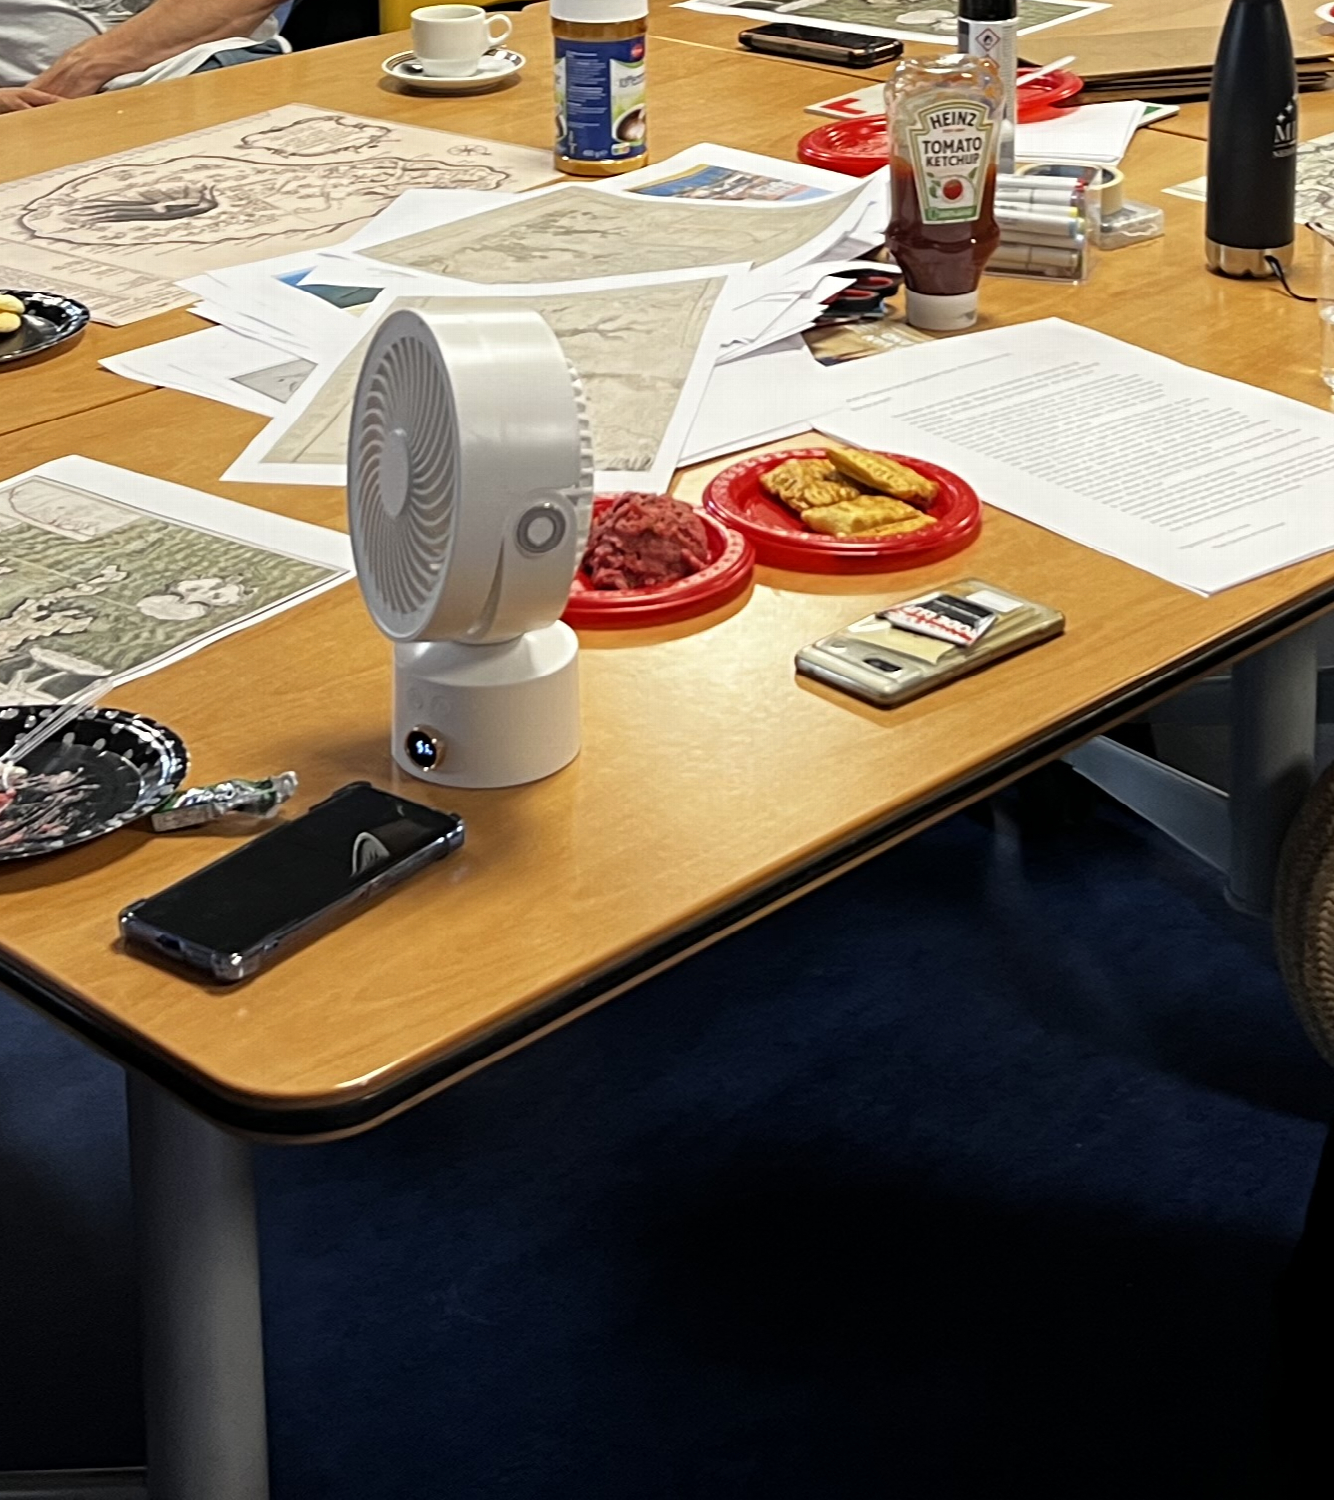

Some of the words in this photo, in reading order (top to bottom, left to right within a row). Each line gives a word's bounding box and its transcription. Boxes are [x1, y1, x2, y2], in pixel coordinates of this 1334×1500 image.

[930, 111, 977, 129] HEINZ
[922, 136, 982, 154] TOMATO
[926, 152, 979, 167] KETCHUP
